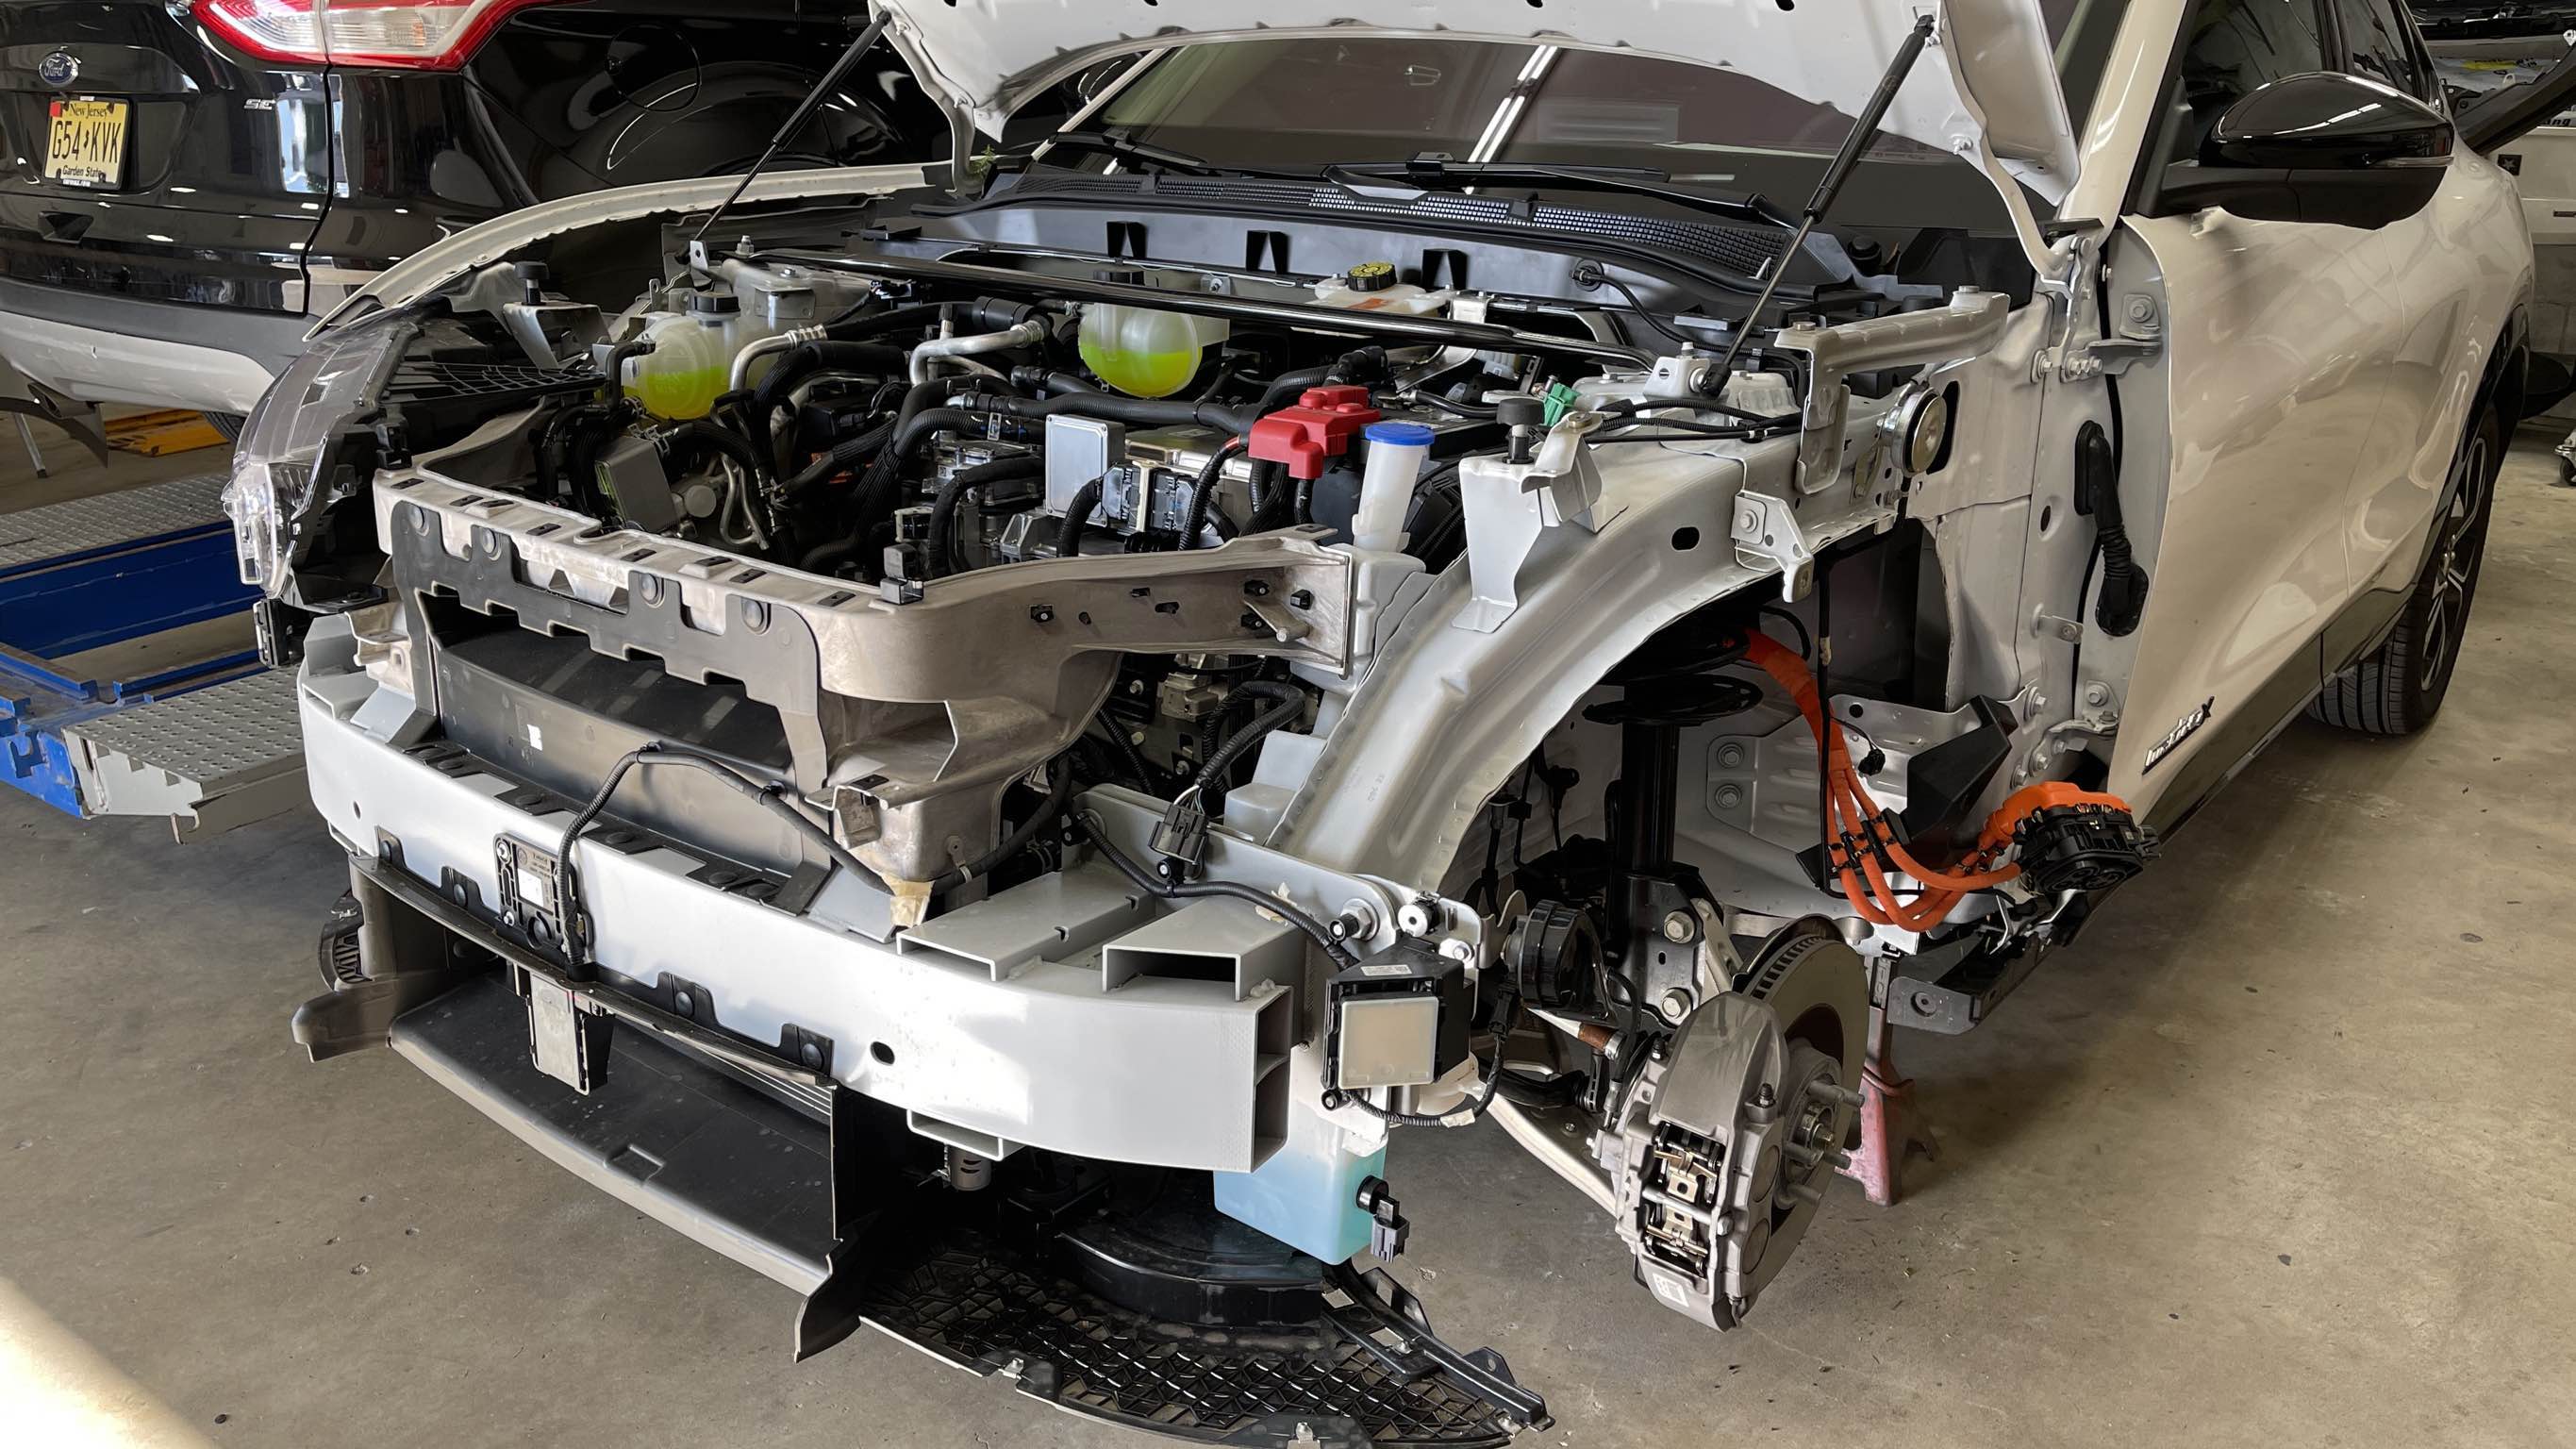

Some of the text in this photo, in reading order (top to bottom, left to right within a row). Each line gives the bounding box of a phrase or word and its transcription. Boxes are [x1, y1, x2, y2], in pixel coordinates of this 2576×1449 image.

[44, 58, 65, 76] Ford
[70, 103, 108, 119] New Jersey
[244, 98, 274, 110] SE
[62, 164, 84, 176] Garden
